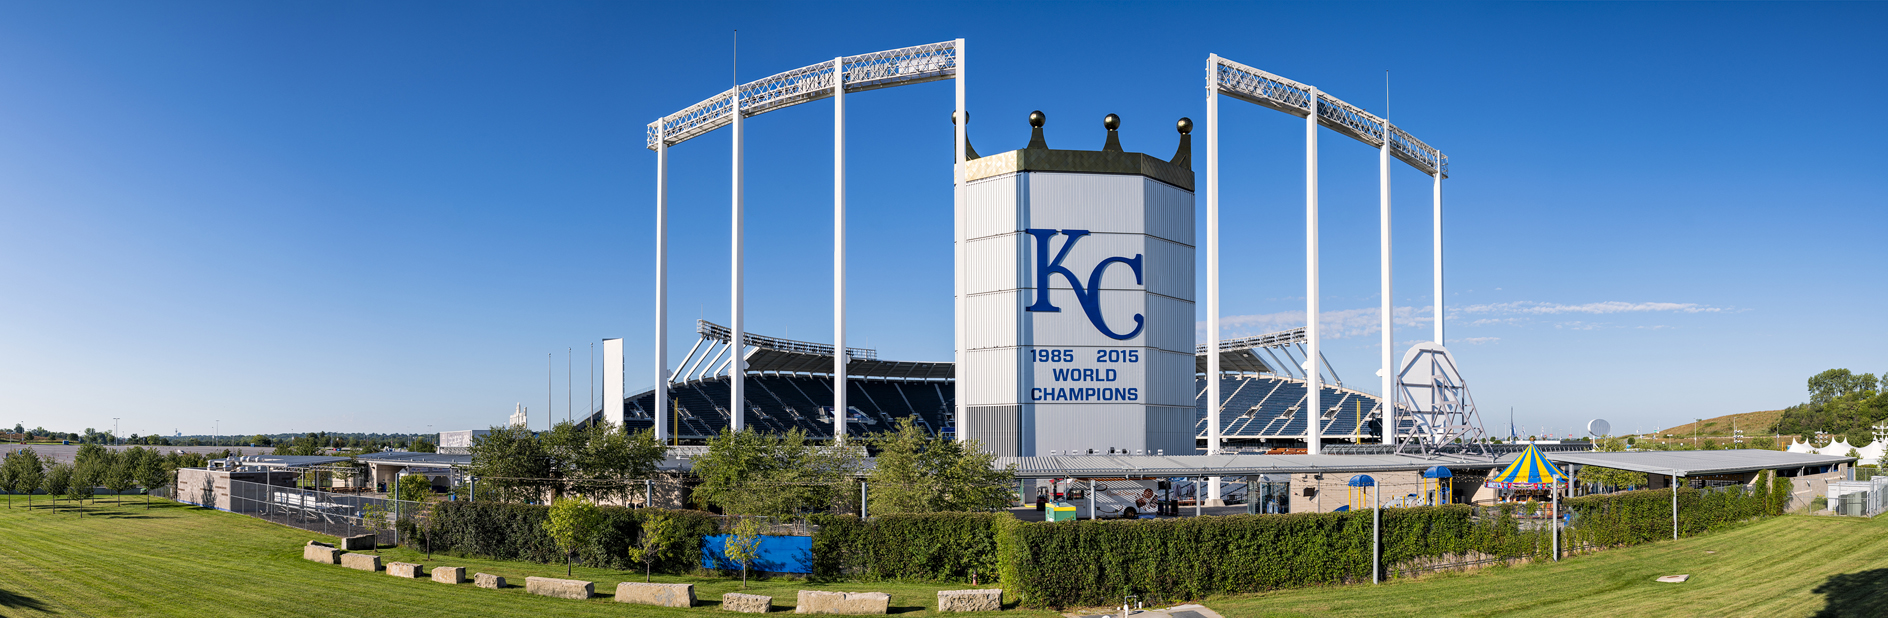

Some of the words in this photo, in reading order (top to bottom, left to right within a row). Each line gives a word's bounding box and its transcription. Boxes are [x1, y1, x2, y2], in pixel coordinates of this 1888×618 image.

[1025, 228, 1143, 340] KC
[1030, 349, 1074, 362] 1985
[1096, 349, 1139, 363] 2015
[1052, 368, 1117, 382] WORLD
[1031, 387, 1138, 401] CHAMPIONS
